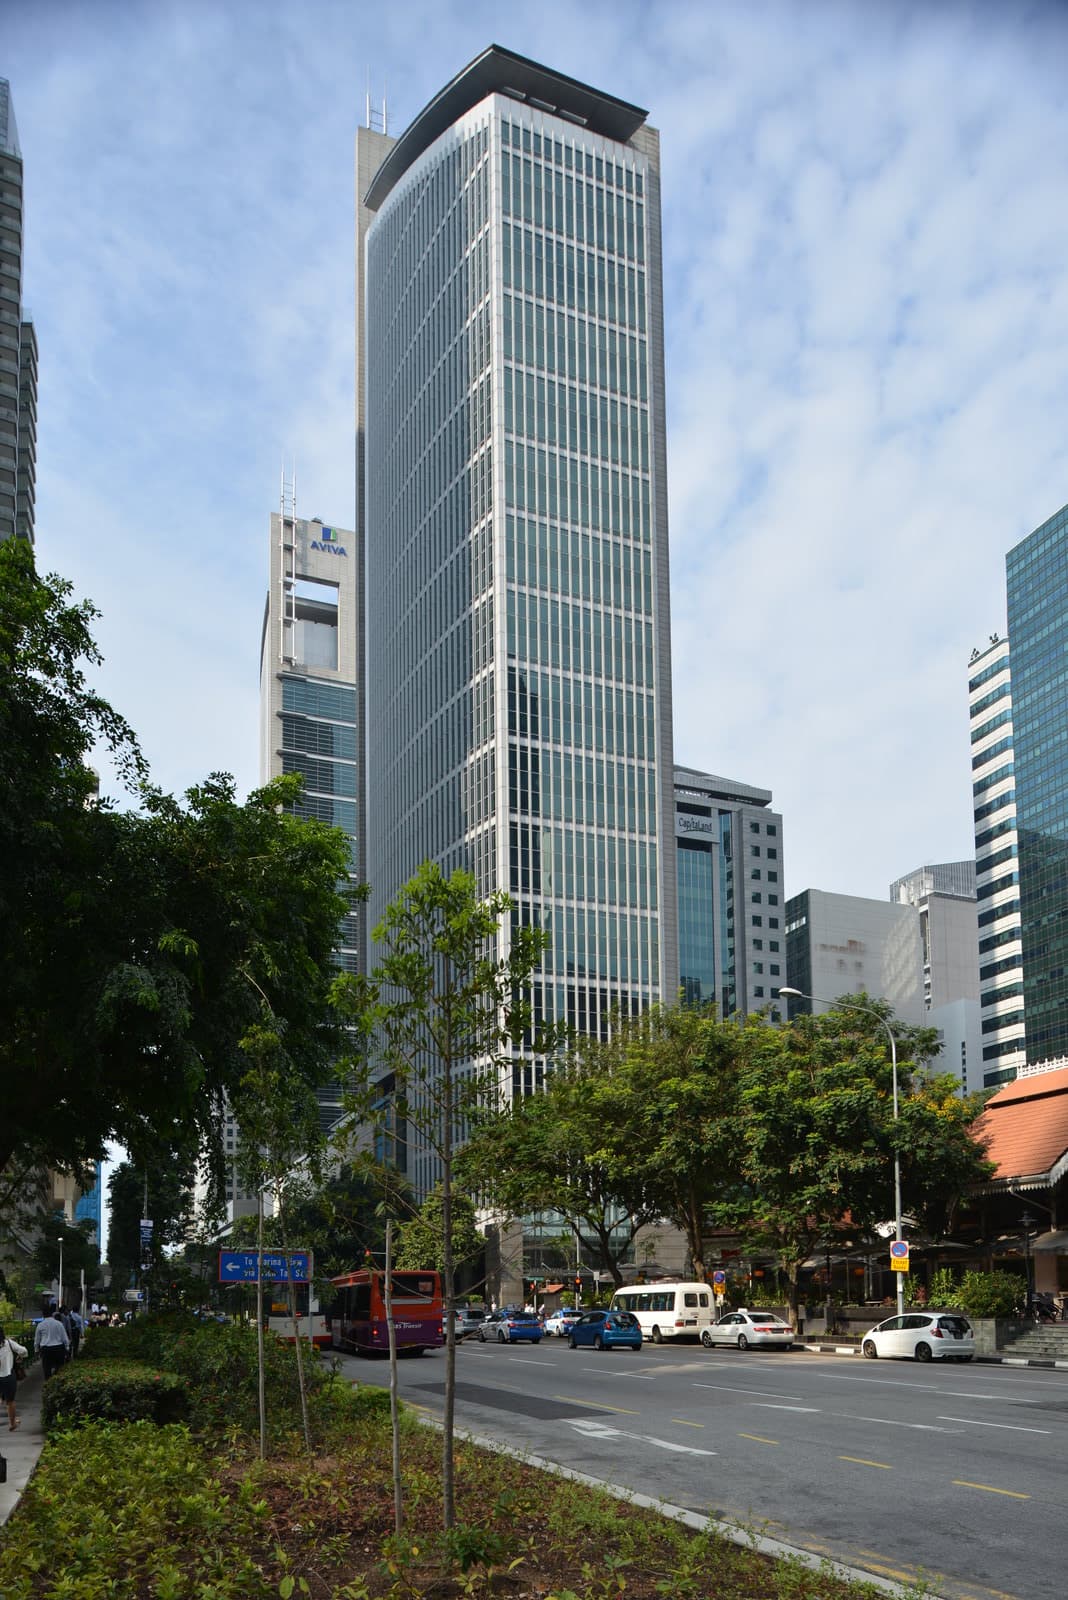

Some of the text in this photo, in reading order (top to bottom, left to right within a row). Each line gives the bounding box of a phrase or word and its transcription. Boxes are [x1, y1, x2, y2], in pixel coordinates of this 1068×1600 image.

[311, 540, 348, 557] AVIVA
[244, 1256, 253, 1265] To
[257, 1256, 281, 1265] arina
